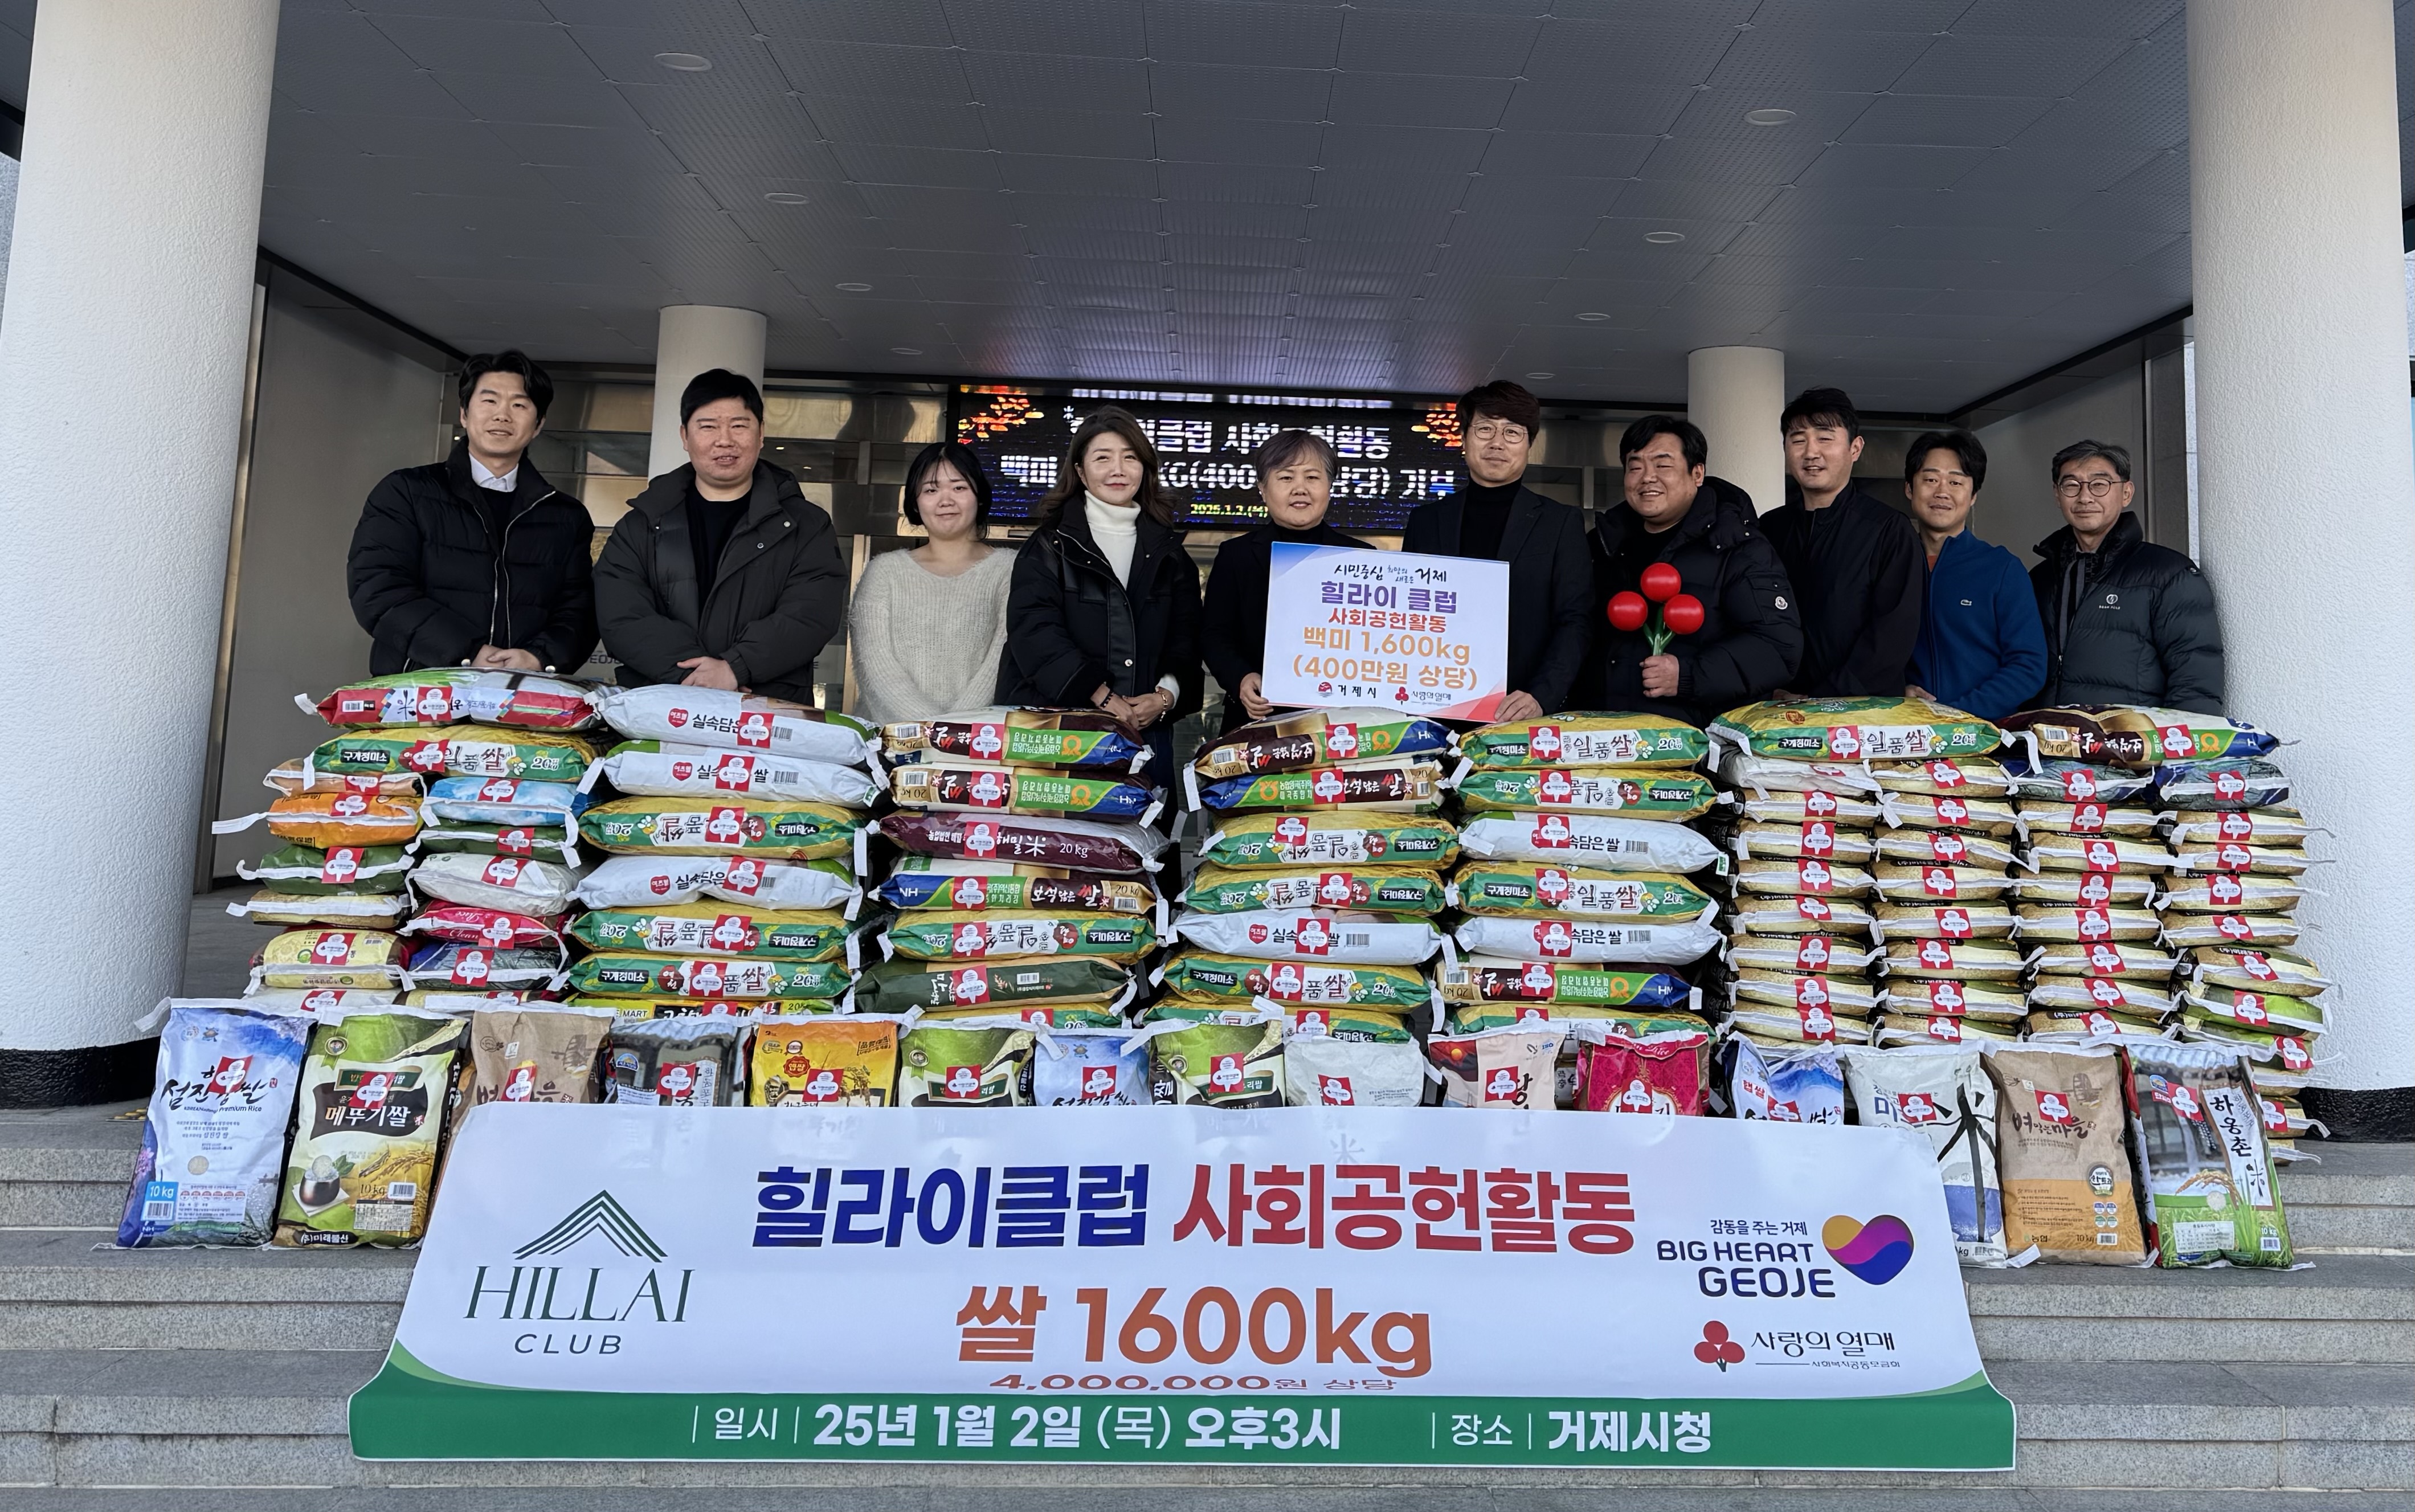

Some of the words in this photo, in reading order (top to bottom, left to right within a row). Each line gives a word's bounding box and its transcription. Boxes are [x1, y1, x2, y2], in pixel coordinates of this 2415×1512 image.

[1220, 422, 1391, 459] 사회헌활동
[1000, 455, 1058, 488] 백미
[1334, 564, 1384, 581] 시민중심
[1415, 567, 1447, 585] 거제
[1395, 575, 1415, 584] 새로운
[1321, 581, 1397, 608] 힐라이
[1408, 587, 1457, 614] 클럽
[1328, 607, 1447, 634] 사회공헌활동
[1303, 626, 1351, 651] 백미
[1360, 631, 1470, 666] 1,600kg
[1293, 654, 1409, 686] (400만원
[1417, 664, 1478, 691] 상당)
[692, 713, 740, 734] 실속담은
[935, 726, 957, 749] 쌀
[1574, 734, 1633, 759] 일품쌀
[1865, 729, 1930, 756] 일품쌀
[1250, 745, 1270, 769] 쌀
[754, 767, 769, 783] 쌀
[1363, 781, 1380, 792] 닮은
[1380, 773, 1403, 796] 쌀
[1416, 770, 1428, 779] 20
[941, 774, 964, 799] 쌀
[1059, 843, 1073, 854] 20
[1074, 843, 1089, 858] kg
[1569, 833, 1604, 851] 속담은
[1605, 838, 1620, 853] 쌀
[1031, 885, 1056, 904] 보석
[1059, 890, 1076, 903] 닮은
[1078, 884, 1100, 908] 쌀
[1115, 884, 1128, 894] 20
[1576, 884, 1639, 910] 일품쌀
[1272, 927, 1298, 944] 실속
[1327, 932, 1341, 947] 쌀
[1571, 929, 1605, 945] 속담은
[1608, 930, 1623, 945] 쌀
[724, 966, 767, 994] 품쌀
[1303, 973, 1349, 1000] 품쌀
[1484, 973, 1505, 997] 쌀
[1456, 987, 1469, 998] 20
[623, 1010, 648, 1019] MART
[325, 1106, 411, 1127] 메뚜기쌀
[150, 1185, 159, 1197] 10
[161, 1185, 174, 1199] kg
[360, 1184, 371, 1195] 10
[373, 1184, 386, 1196] kg
[751, 1164, 1150, 1249] 힐라이클럽
[1172, 1163, 1635, 1254] 사회공헌활동
[1710, 1220, 1749, 1236] 감동을
[1751, 1221, 1779, 1236] 주는
[1781, 1221, 1808, 1237] 거제
[2031, 1233, 2048, 1243] 농협
[1657, 1240, 1707, 1262] BIG
[1714, 1242, 1814, 1262] HEART
[463, 1265, 696, 1322] HILLAI
[1698, 1267, 1836, 1298] GEOJE
[955, 1285, 1047, 1363] 쌀
[1076, 1286, 1432, 1378] 1600kg
[514, 1333, 622, 1355] CLUB
[1750, 1329, 1830, 1358] 사랑의
[1836, 1330, 1896, 1357] 열매
[1811, 1360, 1901, 1370] 사회복지공동모금회
[989, 1373, 1308, 1391] 4,000,000원
[1322, 1377, 1397, 1391] 상당
[714, 1407, 778, 1441] 일시
[812, 1403, 916, 1447] 25년
[933, 1404, 995, 1448] 1월
[1010, 1404, 1082, 1449] 2일
[1096, 1405, 1172, 1449] (목)
[1185, 1407, 1342, 1450] 오후3시
[1450, 1414, 1513, 1446] 장소
[1547, 1410, 1711, 1453] 거제시청
